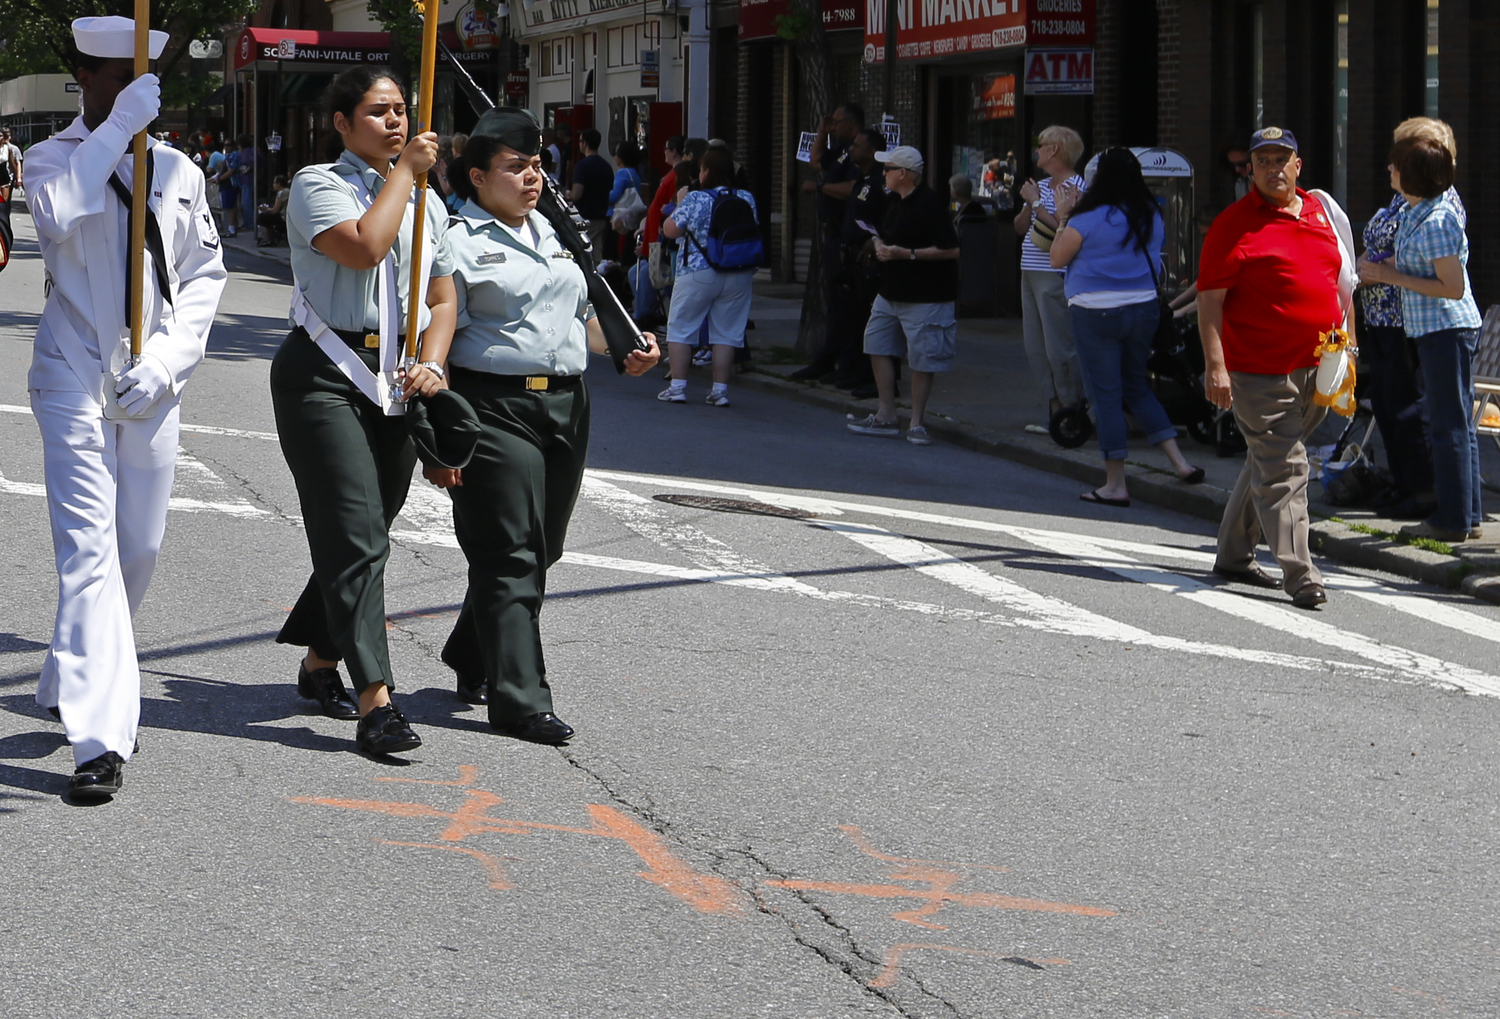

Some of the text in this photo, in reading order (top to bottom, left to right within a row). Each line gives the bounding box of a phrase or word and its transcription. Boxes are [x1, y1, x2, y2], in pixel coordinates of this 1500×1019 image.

[1032, 20, 1086, 35] 718-238-0804
[264, 47, 362, 61] SCFANI-VITALE
[1026, 53, 1092, 80] ATM
